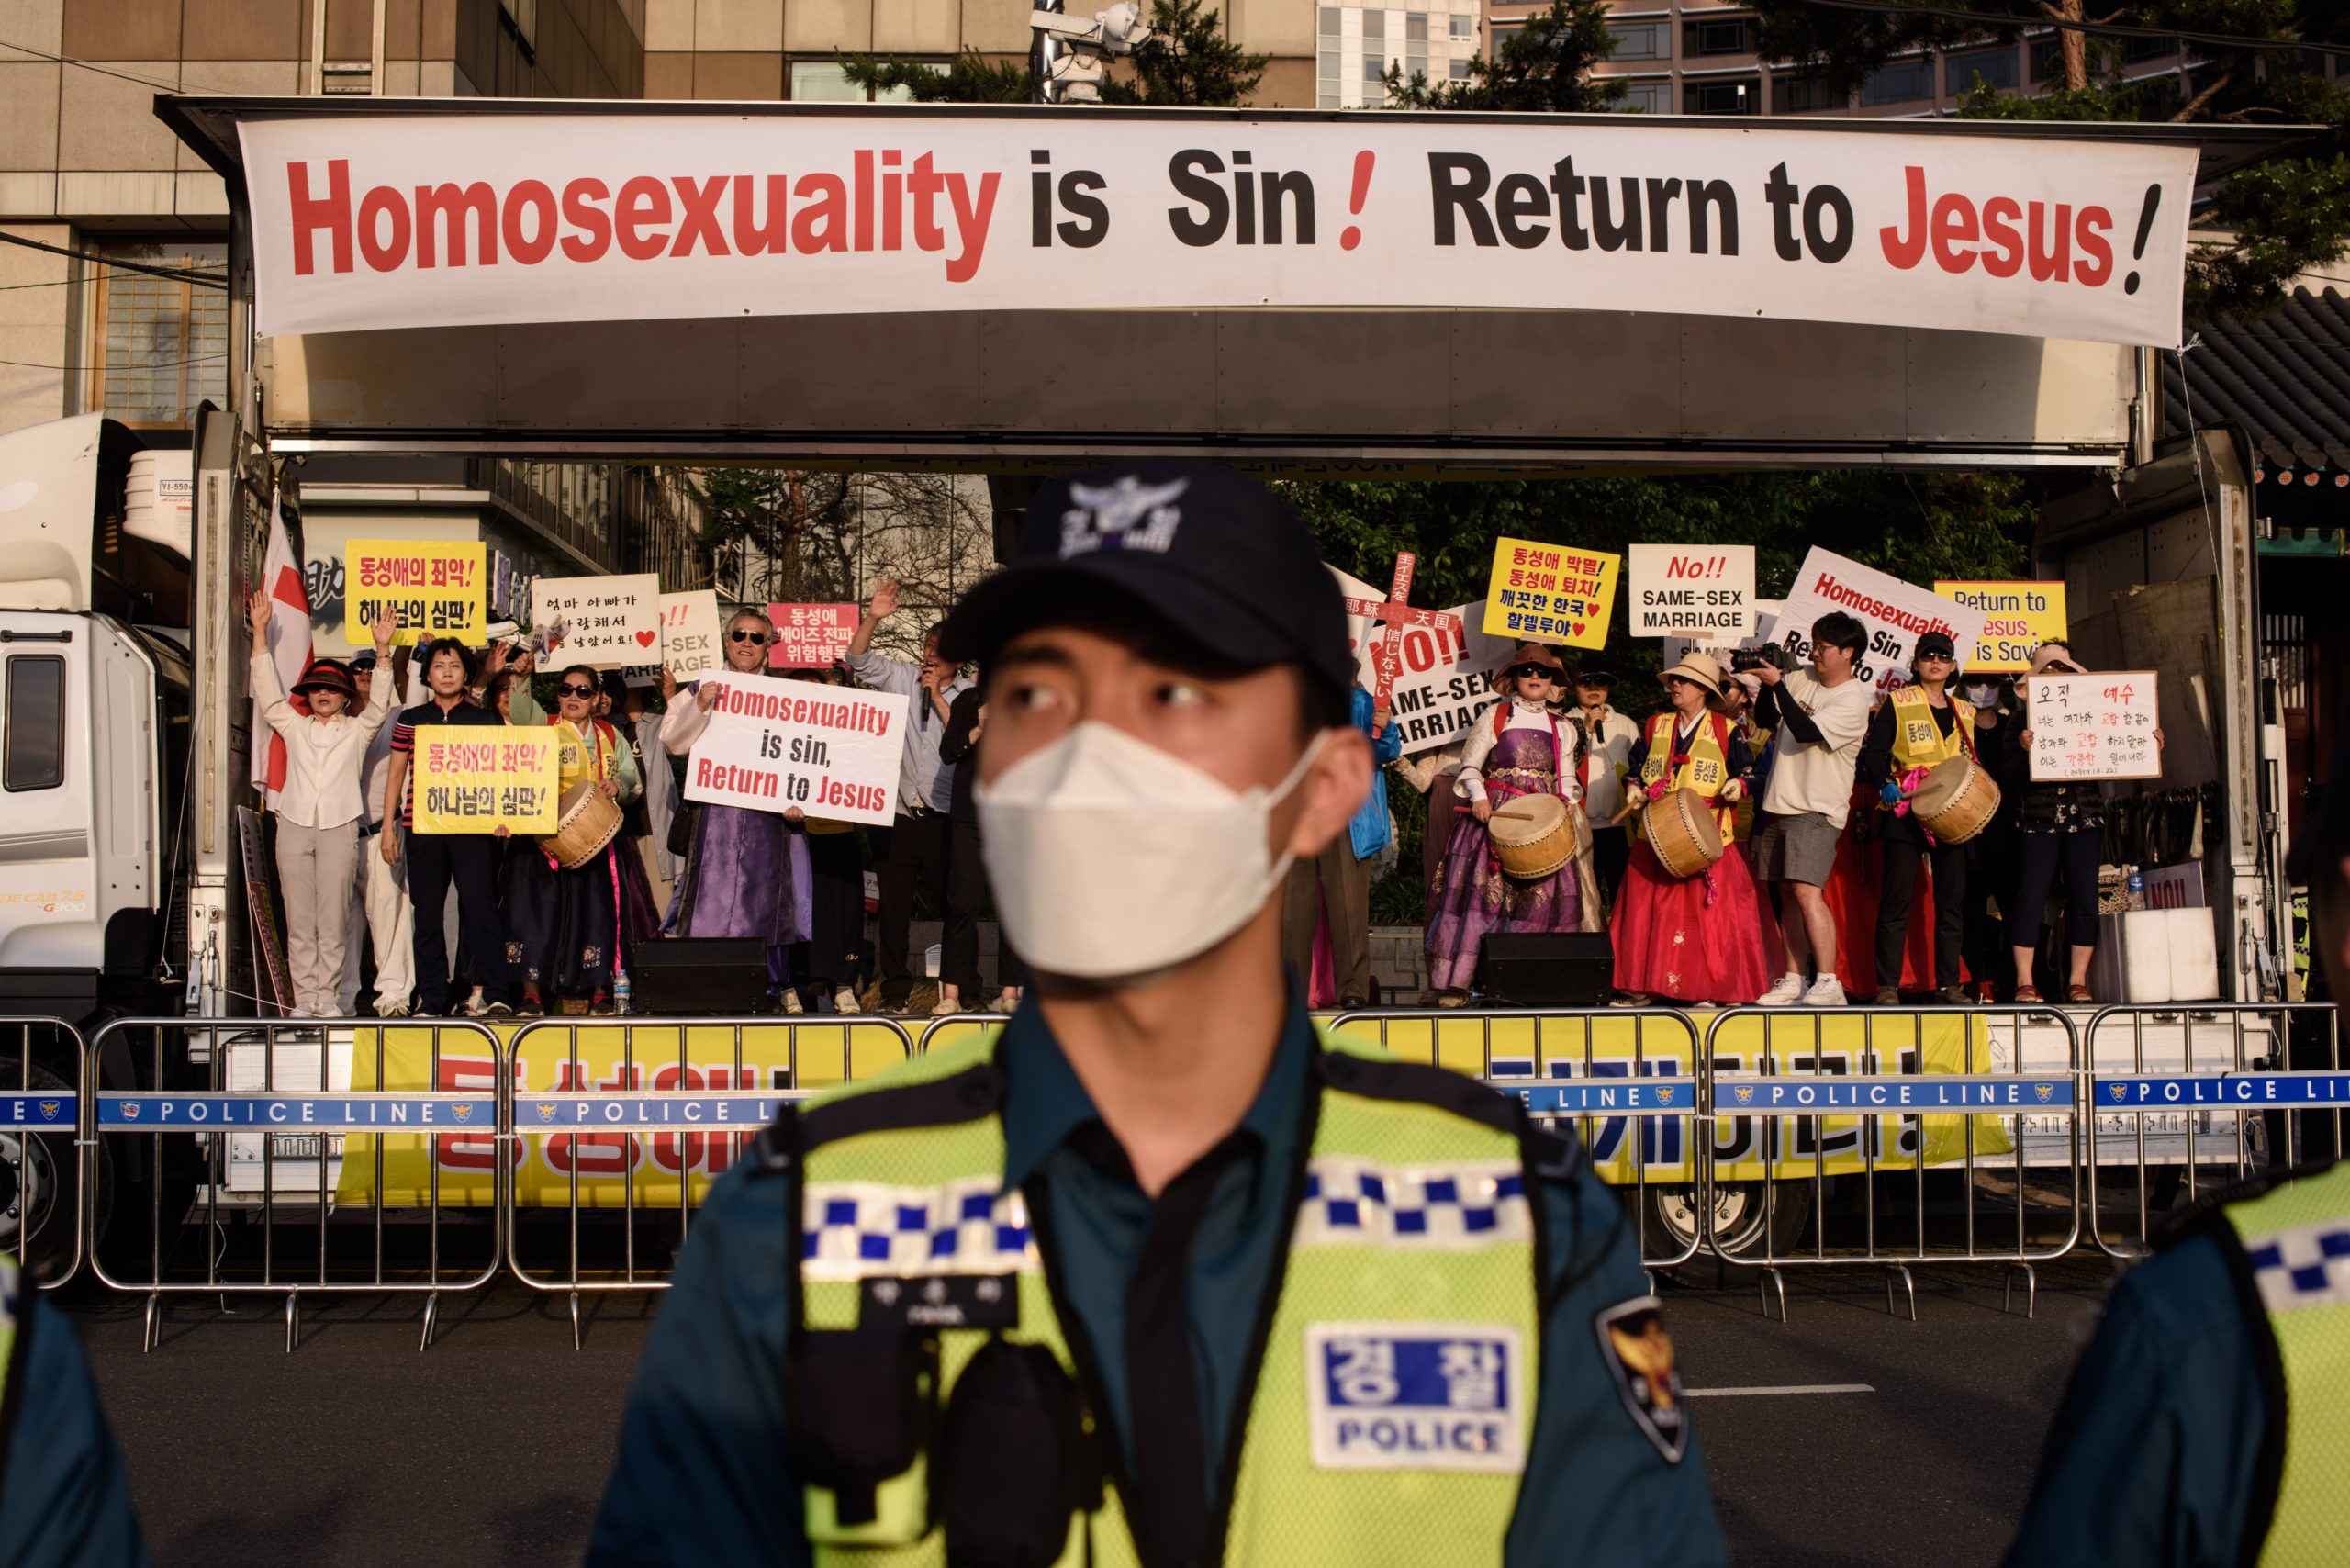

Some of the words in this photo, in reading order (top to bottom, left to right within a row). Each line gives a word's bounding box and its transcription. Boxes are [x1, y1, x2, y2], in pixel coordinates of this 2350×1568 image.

[287, 149, 1002, 283] Homosexuality
[1030, 149, 1110, 249] is
[1427, 151, 1739, 257] Return
[1764, 160, 1854, 264] to
[360, 557, 426, 588] 동성애의
[431, 558, 475, 588] 죄악!
[1513, 547, 1561, 570] 동성애
[1566, 554, 1606, 577] 박멸!
[1666, 556, 1727, 579] No!!
[1509, 568, 1557, 592] 동성애
[1561, 577, 1602, 598] 퇴치!
[547, 597, 579, 611] 엄마
[588, 594, 637, 608] 아빠가
[1499, 588, 1548, 612] 깨끗한
[1553, 597, 1584, 618] 한국
[1643, 589, 1742, 606] SAME-SEX
[2025, 591, 2046, 612] to
[359, 599, 426, 630] 하님의
[431, 600, 475, 630] 심판!
[790, 608, 837, 626] 동성애
[1507, 611, 1572, 637] 할렐루야
[1643, 611, 1743, 628] MARRIAGE
[777, 626, 822, 644] 에이즈
[822, 626, 855, 645] 전파
[1870, 630, 1902, 660] Sin
[1976, 641, 1992, 661] is
[2037, 683, 2070, 708] 오직
[2103, 683, 2135, 706] 예수
[713, 682, 890, 737] Homosexuality
[2064, 711, 2093, 726] 여자와
[559, 745, 577, 764] 성애
[760, 728, 783, 760] is
[789, 734, 831, 769] sin,
[2038, 736, 2067, 750] 남자와
[428, 743, 497, 773] 동성애의
[501, 743, 547, 773] 죄악!
[696, 757, 778, 798] Return
[786, 772, 810, 802] to
[816, 775, 887, 812] Jesus
[427, 786, 496, 816] 하나님의
[500, 786, 547, 816] 심판!
[1559, 1088, 1640, 1107] LINE
[1772, 1085, 1911, 1104] POLICE
[1939, 1084, 2020, 1103] LINE
[2139, 1081, 2277, 1101] POLICE
[161, 1102, 314, 1122] POLICE
[344, 1103, 434, 1123] LINE
[576, 1102, 729, 1122] POLICE
[1336, 1419, 1504, 1454] POLICE
